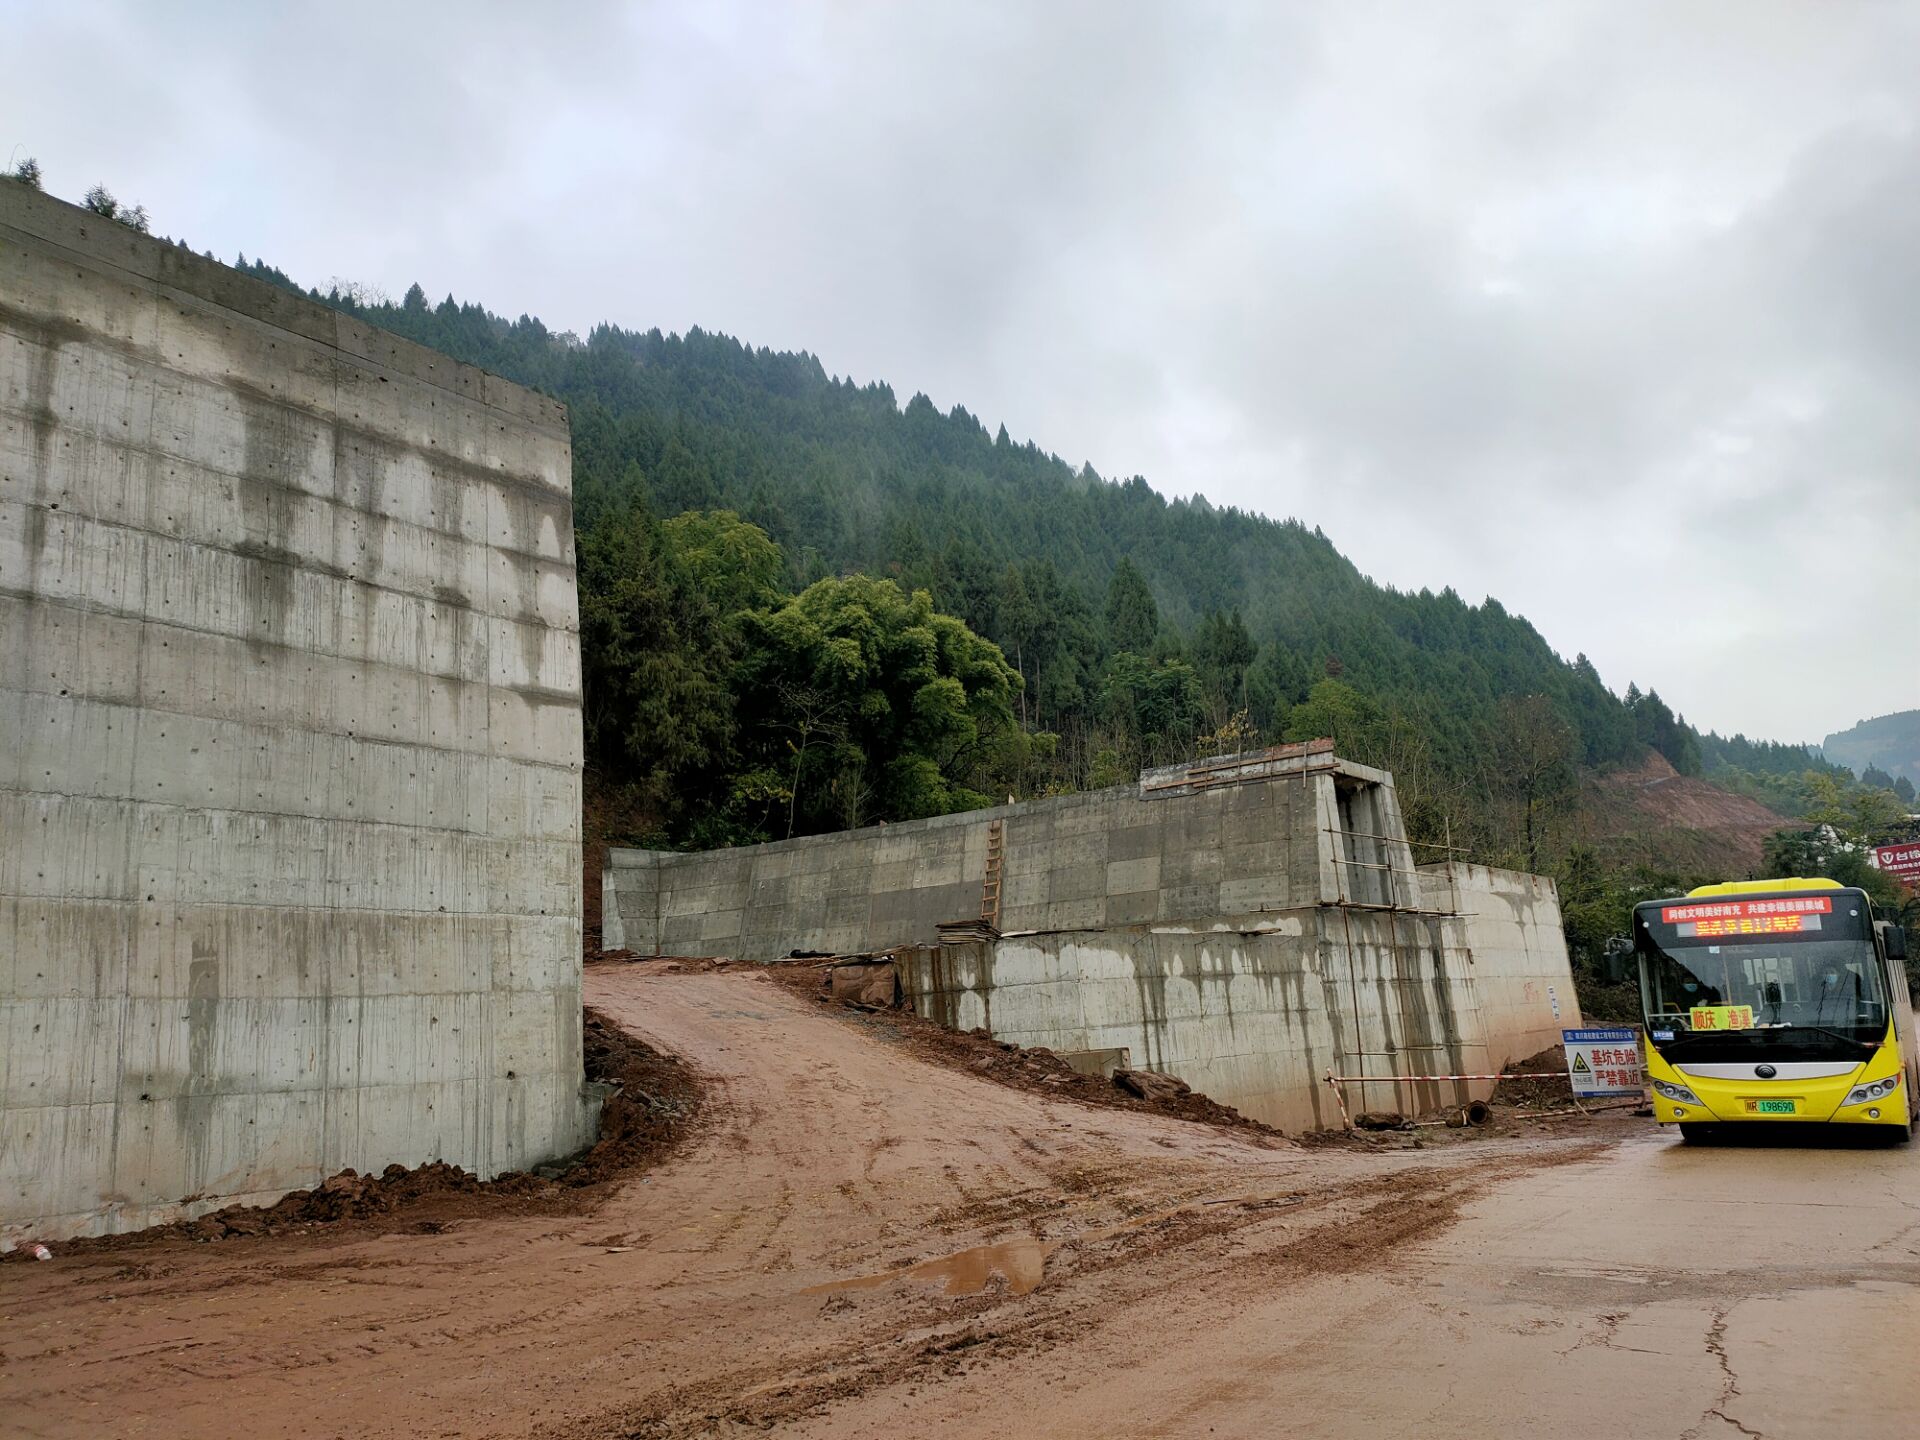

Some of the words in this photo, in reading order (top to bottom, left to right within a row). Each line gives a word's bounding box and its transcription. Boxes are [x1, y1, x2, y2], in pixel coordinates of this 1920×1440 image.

[1692, 1009, 1717, 1029] 顺庆
[1727, 1008, 1751, 1028] 渔溪
[1591, 1048, 1637, 1067] 基坑危险
[1594, 1069, 1640, 1087] 严禁靠近
